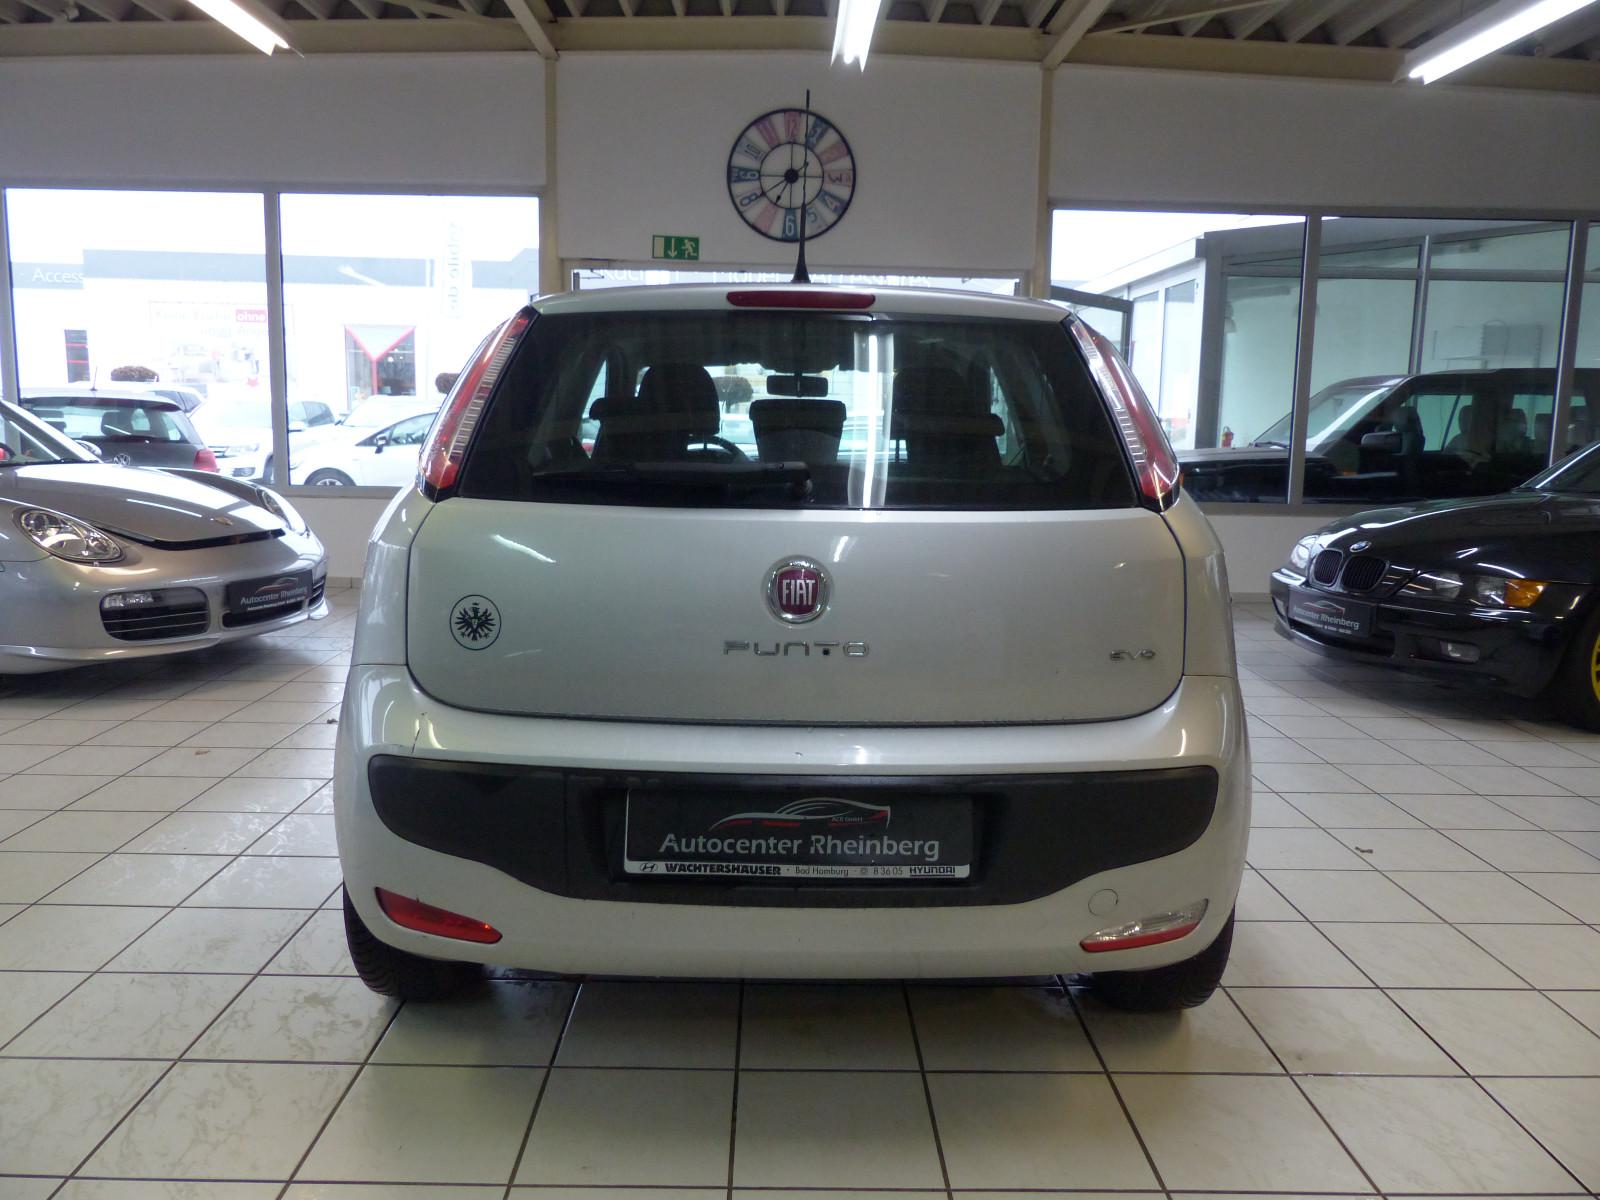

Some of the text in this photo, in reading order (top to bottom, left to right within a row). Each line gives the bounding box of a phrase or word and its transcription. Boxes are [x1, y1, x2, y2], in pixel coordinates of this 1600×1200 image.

[828, 172, 843, 184] 3
[740, 192, 759, 207] 8
[785, 215, 795, 237] 6
[782, 579, 816, 606] FIAT
[723, 640, 869, 656] PUNTO
[659, 832, 940, 861] Autocenter Rheinberg
[795, 866, 810, 875] Bad
[813, 867, 849, 878] Homburg
[909, 866, 956, 875] HYUNDAI
